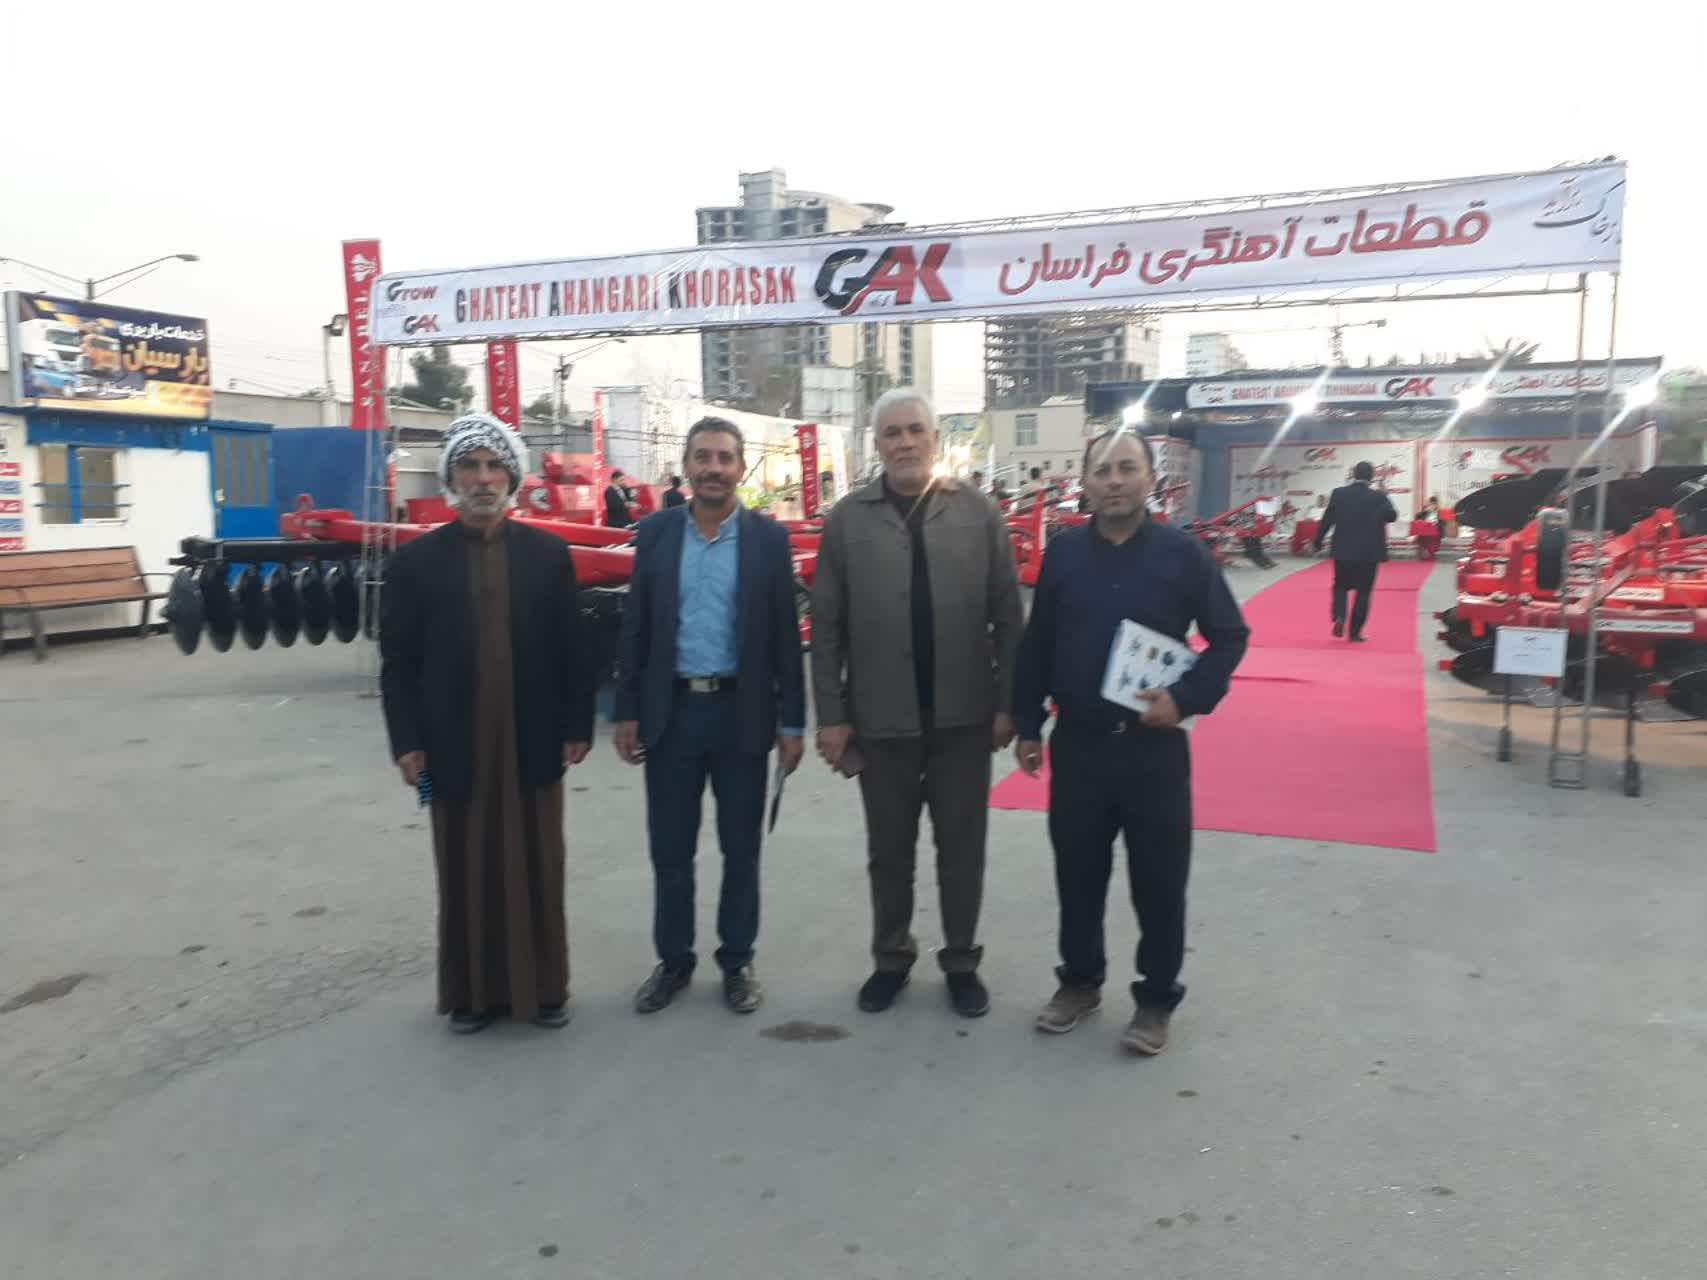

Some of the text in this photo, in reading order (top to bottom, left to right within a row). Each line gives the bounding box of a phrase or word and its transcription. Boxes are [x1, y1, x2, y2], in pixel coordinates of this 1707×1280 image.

[1138, 215, 1304, 285] آهنگری
[1304, 200, 1490, 257] قطعات
[455, 265, 796, 323] GHATEAT AHANGARI KHORASAN
[814, 242, 953, 316] GAK
[403, 313, 440, 335] GAK
[1384, 377, 1435, 399] GAK
